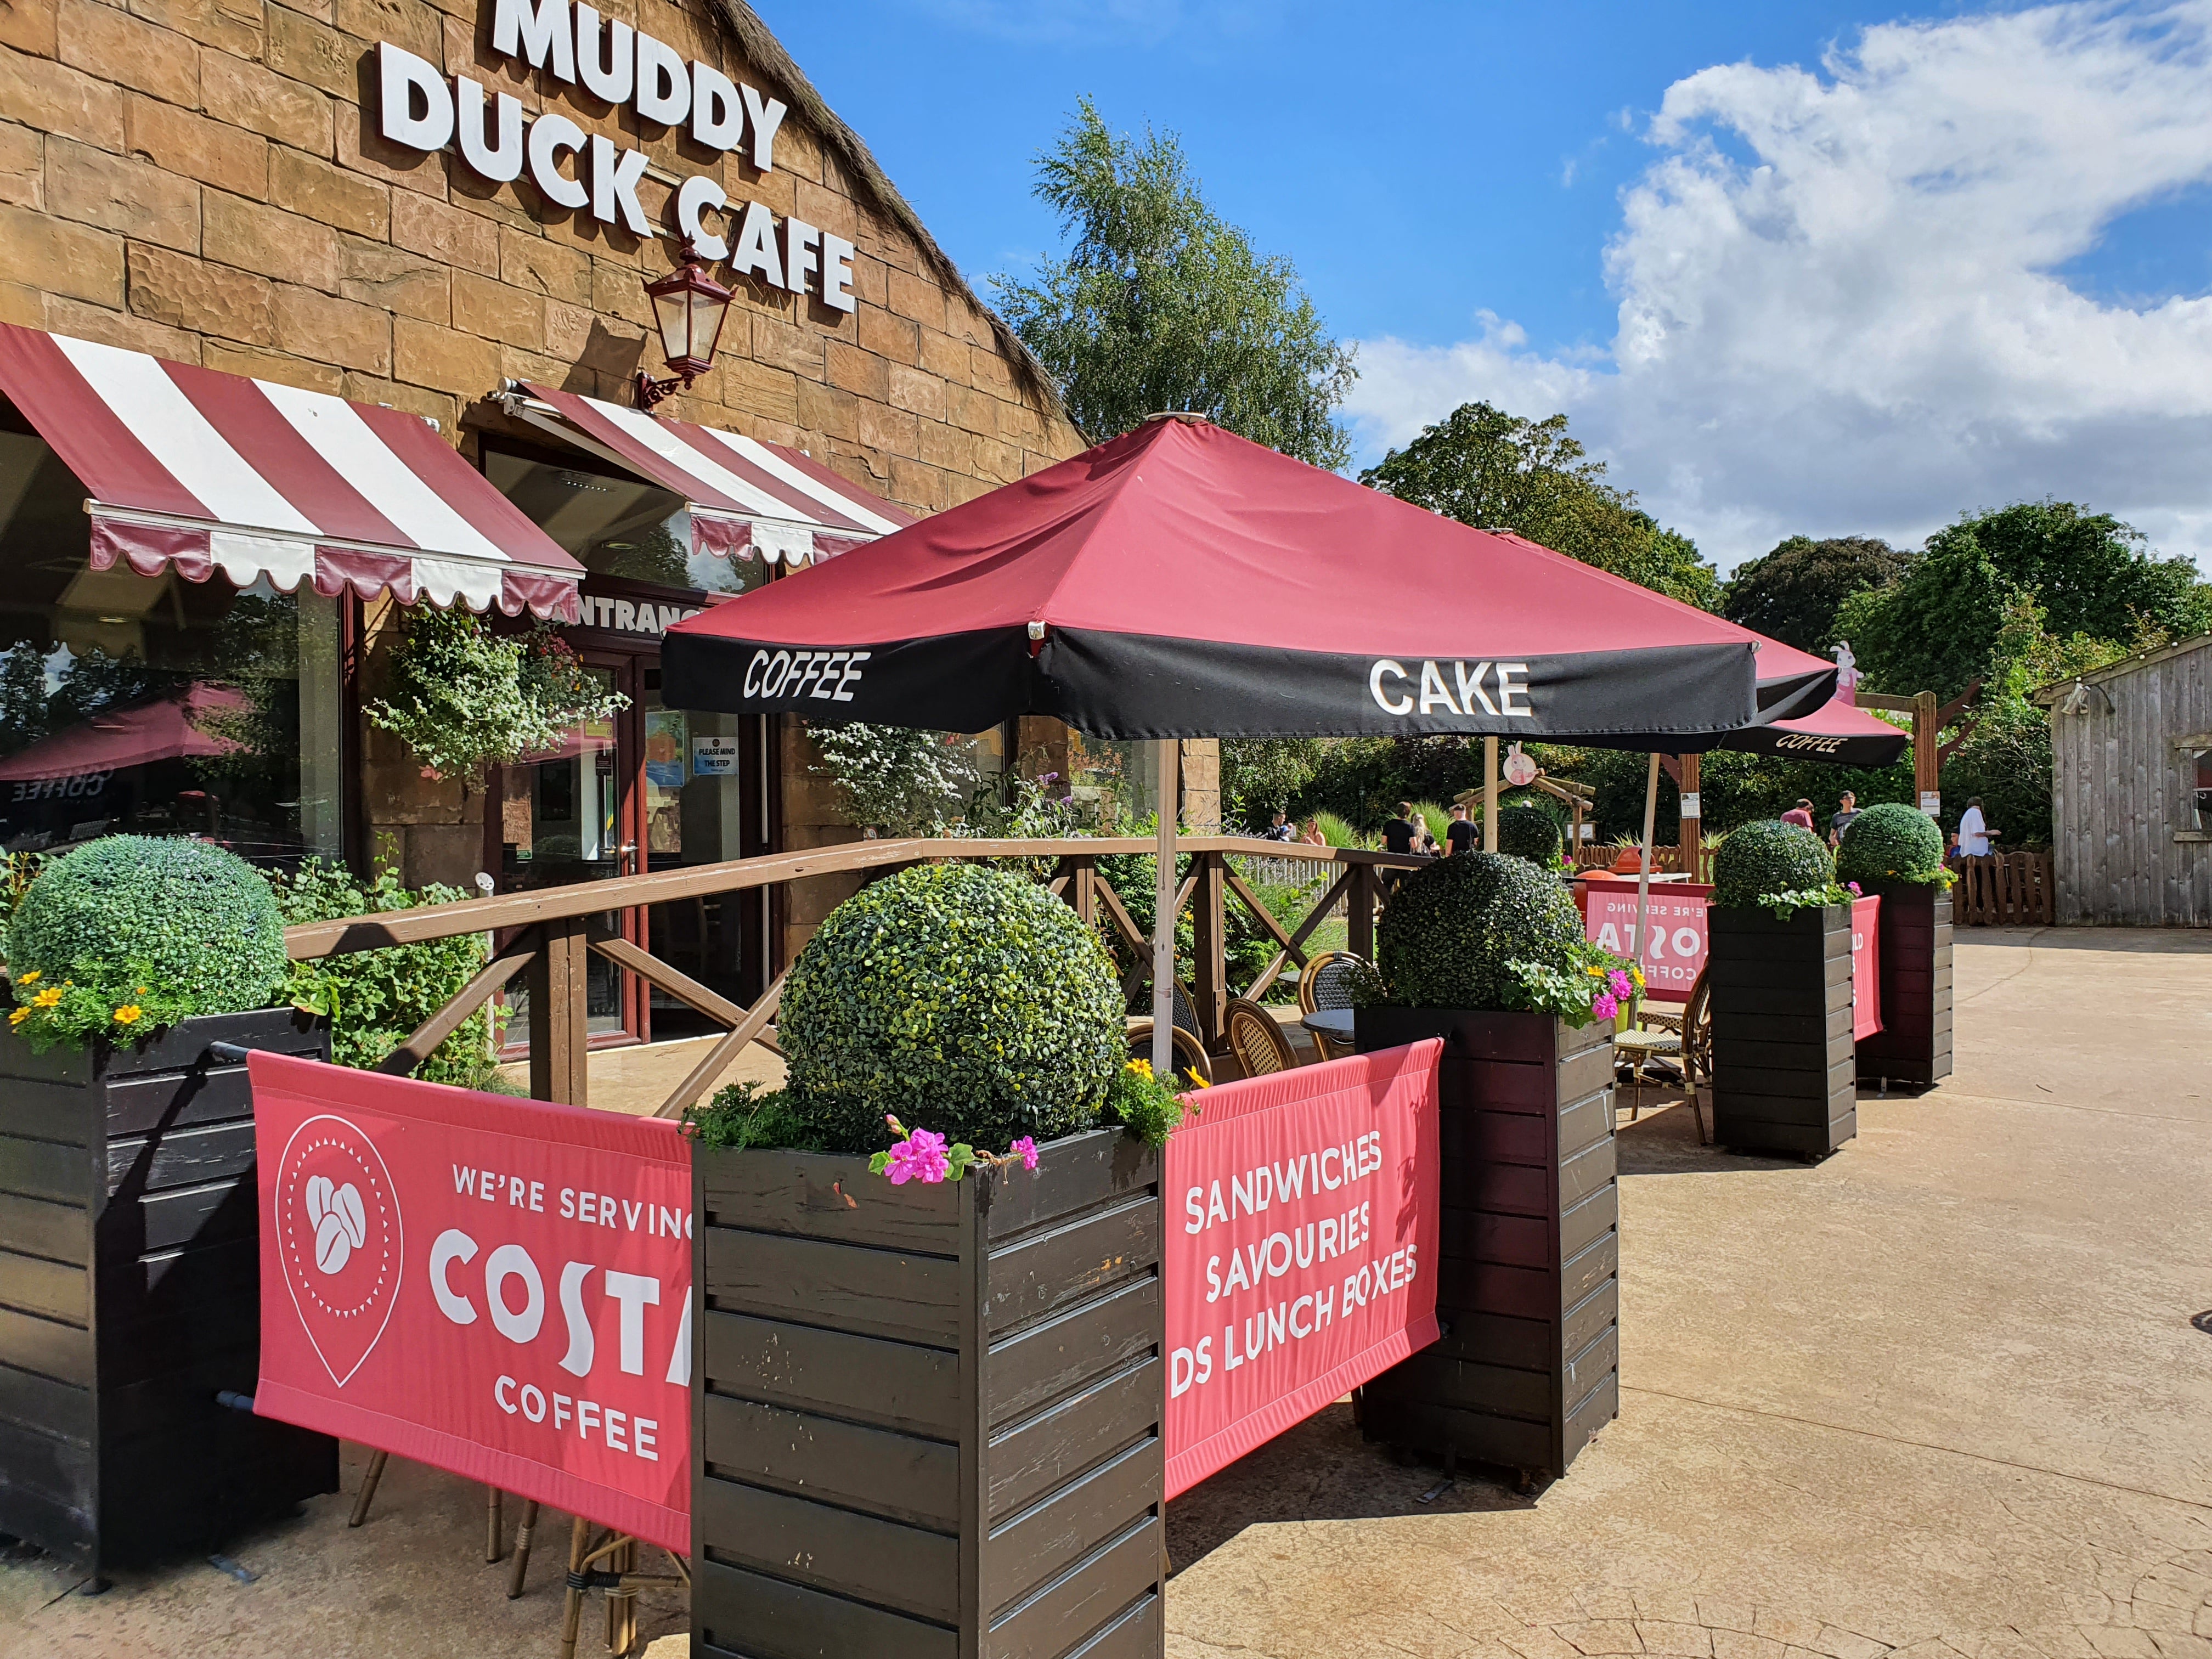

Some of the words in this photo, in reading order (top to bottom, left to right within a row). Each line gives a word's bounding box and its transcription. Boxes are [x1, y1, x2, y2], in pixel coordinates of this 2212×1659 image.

[493, 0, 787, 172] MUDDY
[380, 41, 653, 238] DUCK
[678, 176, 854, 313] CAFE
[743, 649, 872, 702] COFFEE
[1369, 659, 1532, 716] CAKE
[1776, 734, 1848, 753] COFFEE
[452, 1164, 545, 1213] WE'RE
[1184, 1130, 1382, 1235] SANDWICHES
[1206, 1200, 1370, 1304] SAVOURIES
[1224, 1284, 1335, 1372] LUNCH
[1341, 1244, 1418, 1319] BOXES
[494, 1374, 658, 1461] COFFEE
